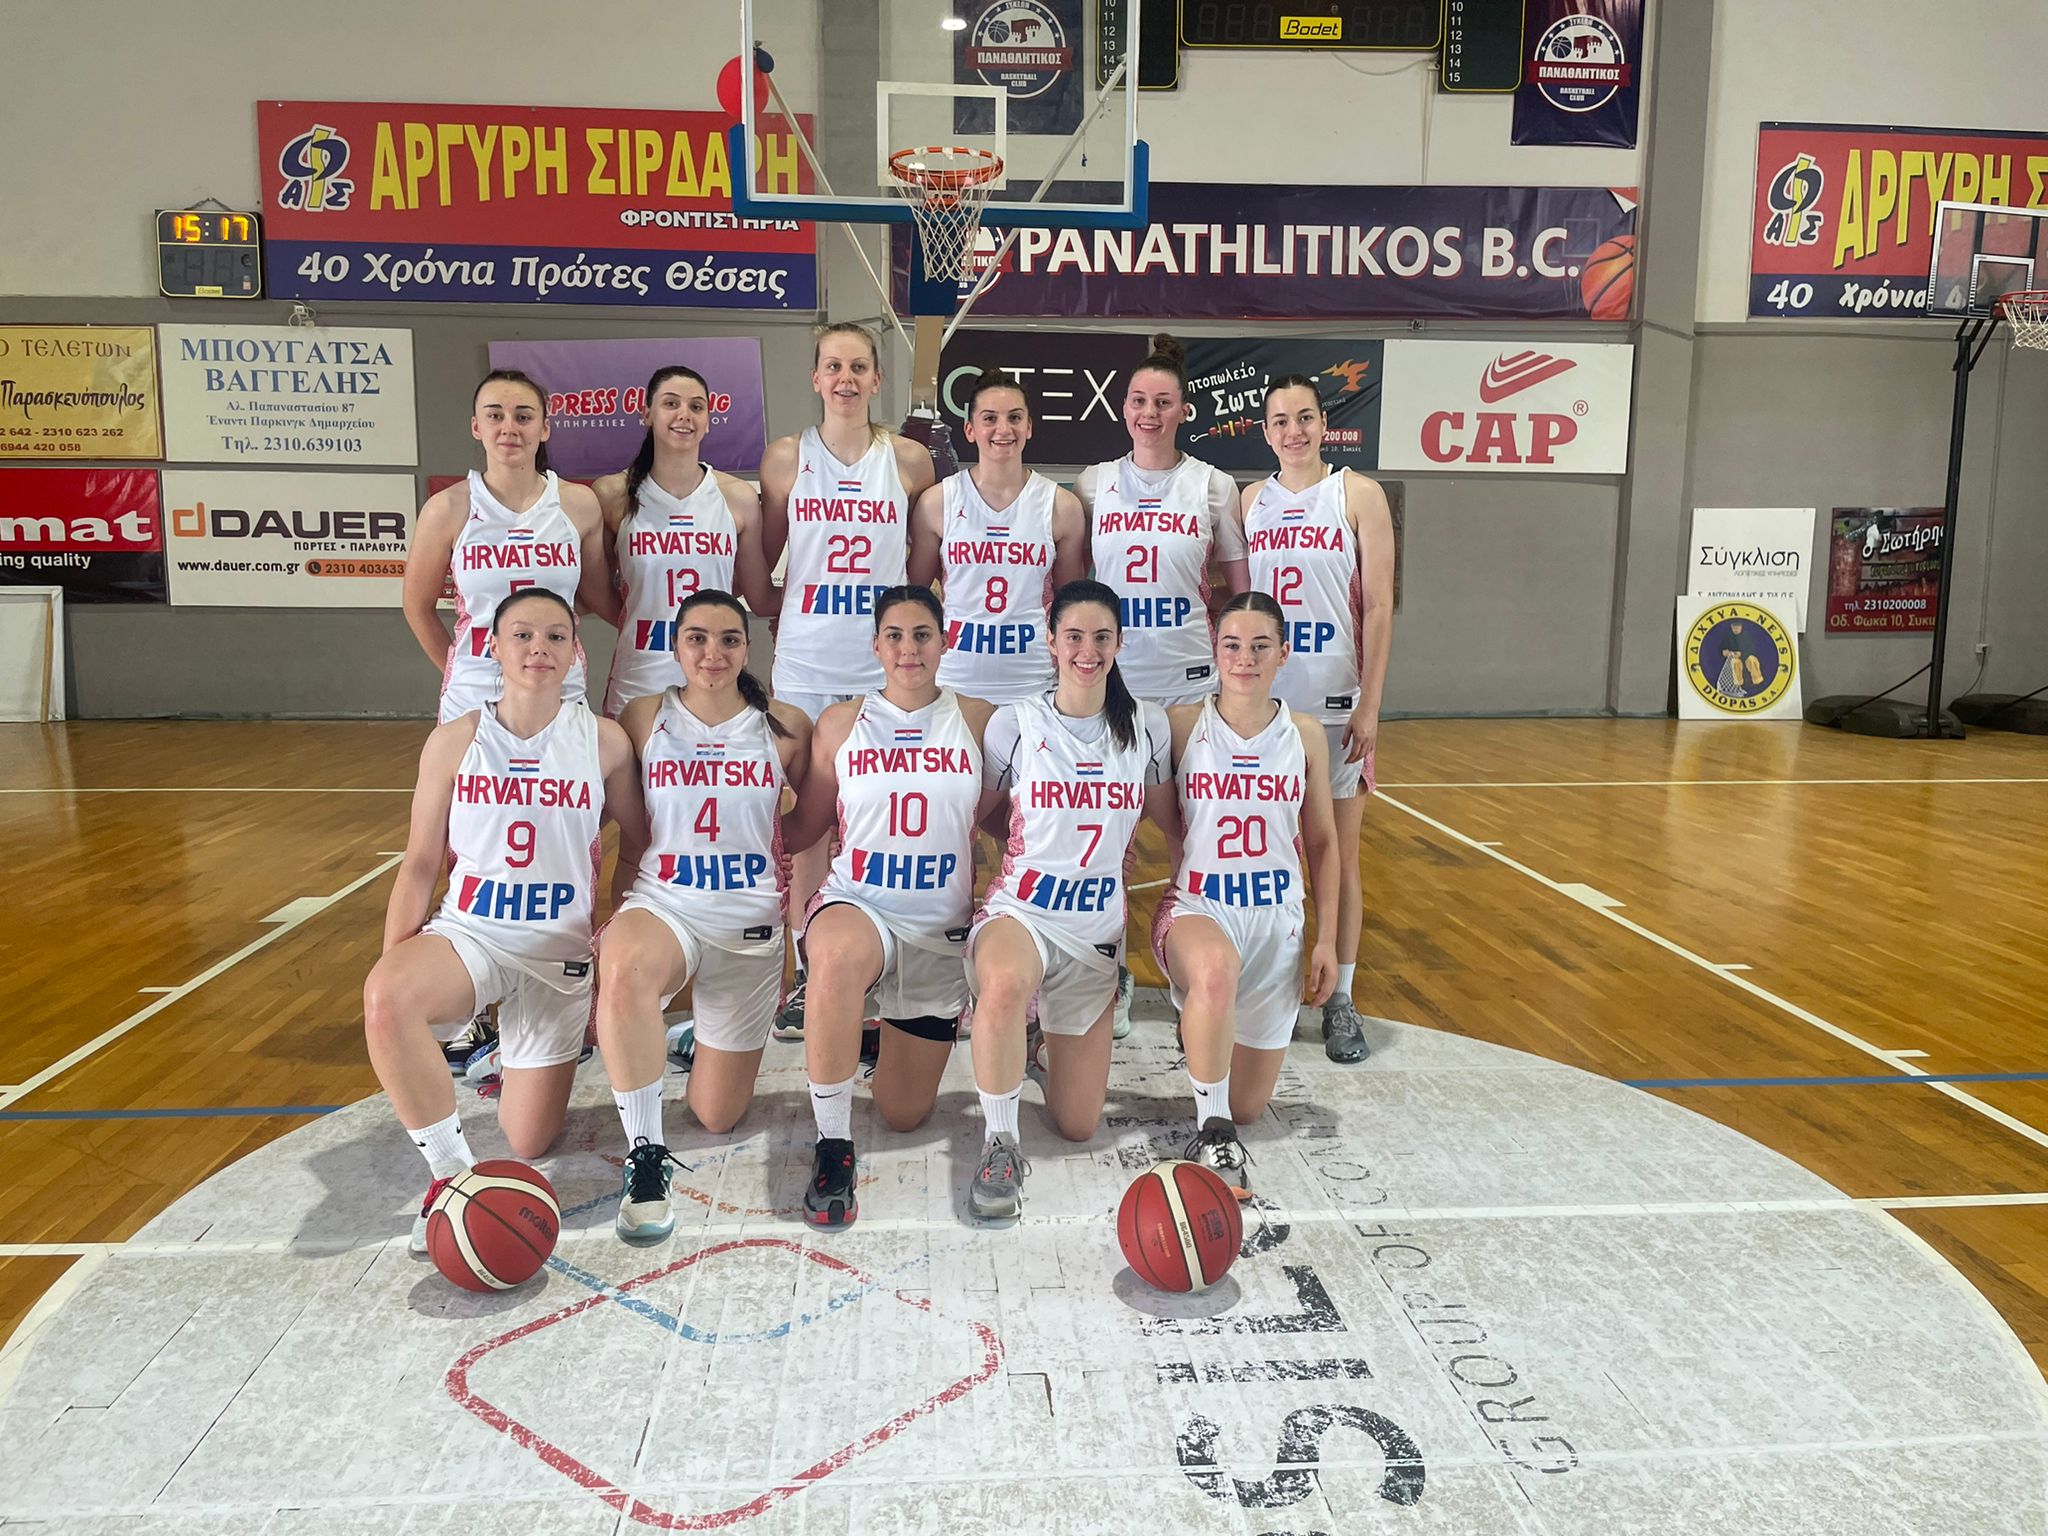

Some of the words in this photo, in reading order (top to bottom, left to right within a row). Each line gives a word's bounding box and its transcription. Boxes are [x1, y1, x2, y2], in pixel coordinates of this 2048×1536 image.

[1103, 12, 1116, 21] 11
[1450, 2, 1464, 12] 10
[1103, 27, 1116, 37] 12
[1283, 19, 1339, 36] Bodet
[1450, 17, 1462, 26] 11
[1103, 41, 1116, 50] 13
[1450, 31, 1463, 41] 12
[1450, 44, 1462, 54] 13
[977, 51, 1062, 65] ΠΑΝΑΘΛΗΤΙΚΟΣ
[1103, 56, 1115, 65] 14
[1449, 58, 1462, 68] 14
[1000, 73, 1038, 81] BASKETBALL
[1011, 80, 1027, 88] CLUB
[1448, 73, 1461, 83] 15
[1539, 66, 1620, 81] ΠΑΝΑΘΛΗΤΙΚΟΣ
[370, 121, 568, 211] ΑΡΓΥΡΗ
[1833, 148, 2012, 270] ΑΡΓΥΡΗ
[1020, 223, 1461, 278] PANATHLITIKOS
[1481, 226, 1579, 277] B.C.
[363, 248, 495, 292] Χρόνια
[512, 252, 651, 297] Πρώτες
[665, 255, 788, 300] Θέσεις
[1838, 279, 1926, 313] Χρόνια
[180, 338, 394, 366] ΜΠΟΥΓΑΤΣΑ
[205, 368, 381, 395] ΒΑΓΓΕΛΗΣ
[1187, 361, 1256, 393] ητοπωλείο
[1, 380, 145, 420] Παρασκευόπουλος
[249, 401, 339, 413] Παπαναστασίου
[342, 403, 355, 413] 87
[548, 387, 619, 417] PRESS
[10, 428, 32, 437] 642
[42, 428, 73, 437] 2310
[76, 428, 98, 437] 623
[102, 428, 124, 437] 262
[206, 415, 247, 427] Έναντι
[250, 416, 306, 429] Παρκινγκ
[309, 417, 376, 431] Δημαρχείου
[554, 418, 626, 429] ΥΠΗΡΕΣΙΕΣ
[1342, 431, 1359, 442] 008
[1420, 410, 1578, 464] CAP
[0, 443, 30, 452] 6944
[33, 443, 55, 452] 420
[59, 443, 81, 452] 058
[221, 436, 259, 454] Τηλ.
[263, 437, 363, 453] 2310.639103
[211, 509, 406, 540] DAUER
[795, 498, 898, 524] HRVATSKA
[1098, 511, 1200, 539] HRVATSKA
[0, 510, 153, 542] mat
[1249, 526, 1344, 554] HRVATSKA
[293, 541, 337, 551] ΠΟΡΤΕΣ
[350, 542, 407, 552] ΠΑΡΑΘΥΡΑ
[462, 543, 578, 571] HRVATSKA
[630, 531, 733, 557] HRVATSKA
[827, 534, 873, 574] 22
[948, 541, 1047, 568] HRVATSKA
[1700, 546, 1800, 570] Σύγκλιση
[31, 553, 92, 569] quality
[177, 560, 301, 575] www.dauer.com.gr
[325, 563, 356, 574] 2310
[358, 563, 405, 575] 403633
[1125, 545, 1159, 584] 21
[666, 568, 701, 608] 13
[984, 575, 1009, 614] 8
[1272, 566, 1303, 606] 12
[1133, 597, 1191, 628] HEP
[1863, 599, 1927, 610] 2310200008
[1830, 614, 1850, 627] Οδ.
[1854, 614, 1887, 627] Φωκά
[976, 623, 1036, 655] HEP
[1756, 615, 1788, 655] NETS
[1703, 685, 1757, 709] DIOPAS
[648, 760, 775, 789] HRVATSKA
[848, 747, 973, 777] HRVATSKA
[457, 773, 592, 811] HRVATSKA
[1031, 780, 1145, 810] HRVATSKA
[1186, 772, 1301, 804] HRVATSKA
[694, 797, 721, 843] 4
[888, 791, 928, 838] 10
[505, 820, 537, 869] 9
[1076, 824, 1103, 868] 7
[1216, 815, 1267, 860] 20
[696, 853, 767, 891] HEP
[885, 853, 957, 890] HEP
[494, 882, 576, 922] HEP
[1051, 876, 1117, 913] HEP
[1225, 869, 1290, 908] HEP
[1354, 1222, 1433, 1270] OF
[1403, 1291, 1578, 1474] GROUP
